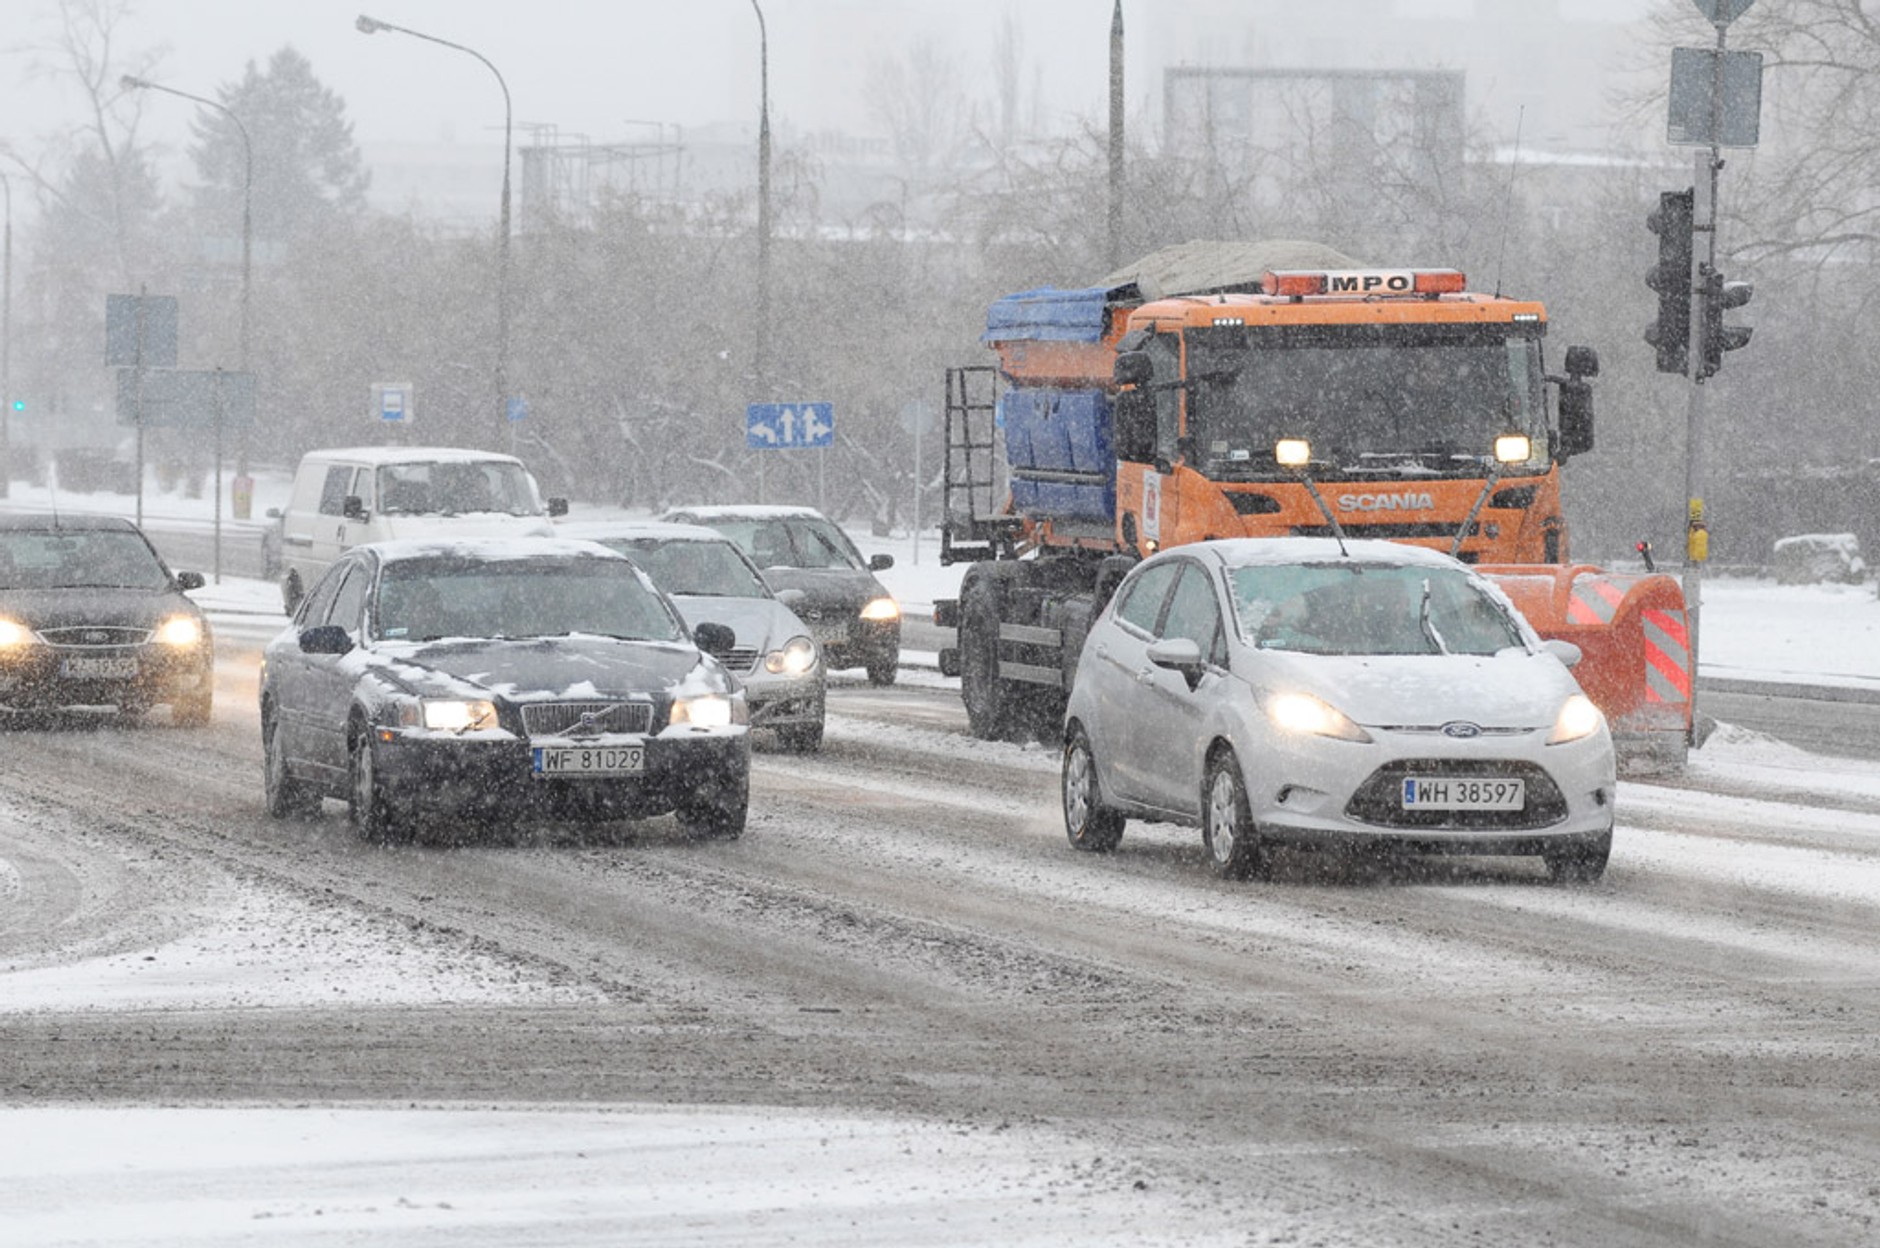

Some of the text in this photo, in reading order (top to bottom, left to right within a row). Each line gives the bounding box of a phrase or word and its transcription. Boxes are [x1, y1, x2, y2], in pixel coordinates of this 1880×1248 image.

[1332, 276, 1409, 292] MPO
[1338, 492, 1434, 512] SCANIA
[545, 750, 641, 769] WF 81029
[1418, 782, 1520, 804] WH 38597
